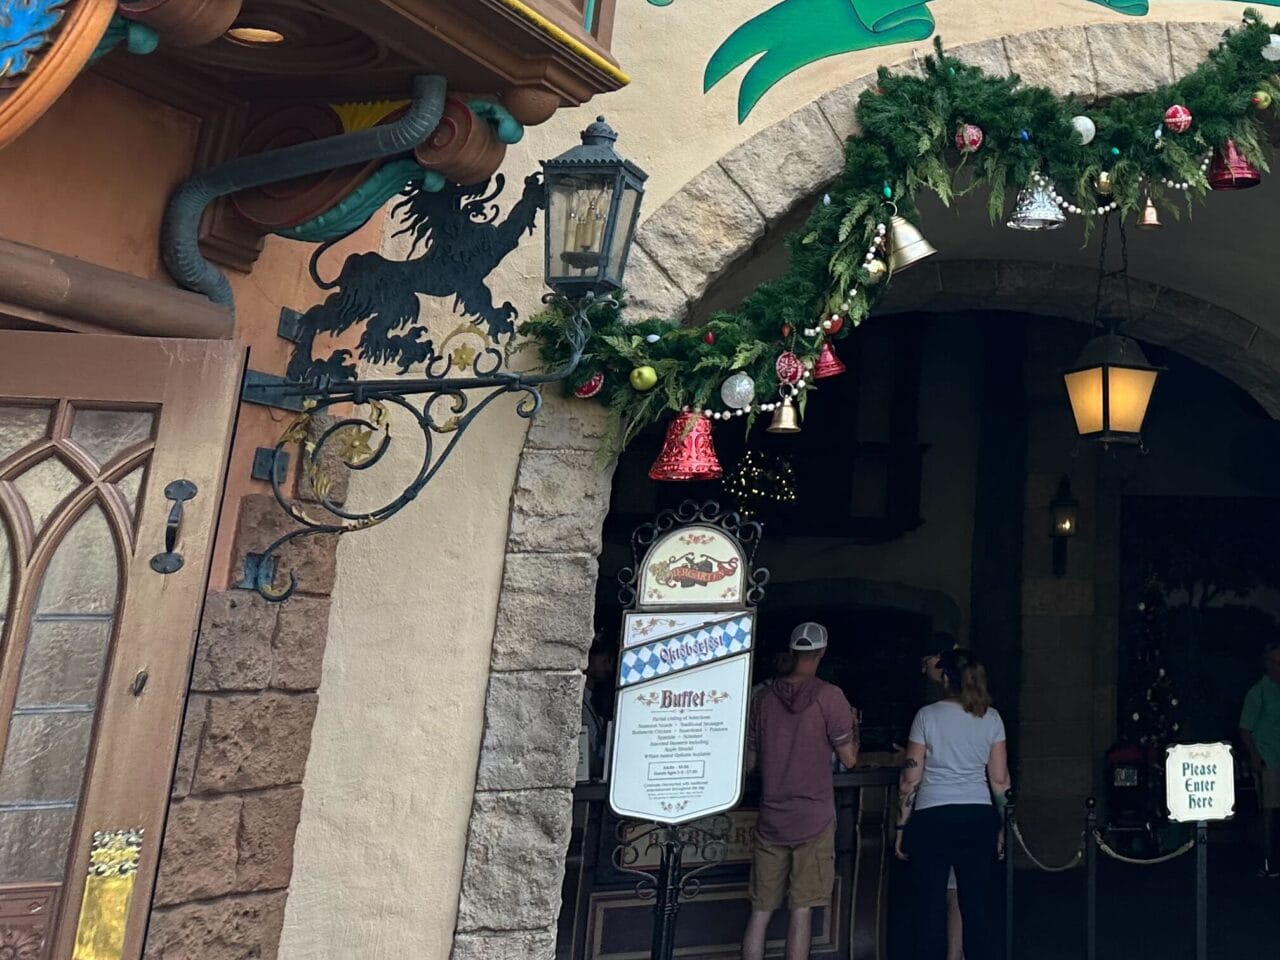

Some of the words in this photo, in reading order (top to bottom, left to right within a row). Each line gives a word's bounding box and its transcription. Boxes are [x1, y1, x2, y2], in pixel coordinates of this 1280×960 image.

[660, 690, 706, 708] Buffet
[1182, 762, 1217, 776] Please
[1185, 778, 1215, 792] Enter
[1188, 794, 1213, 808] Here
